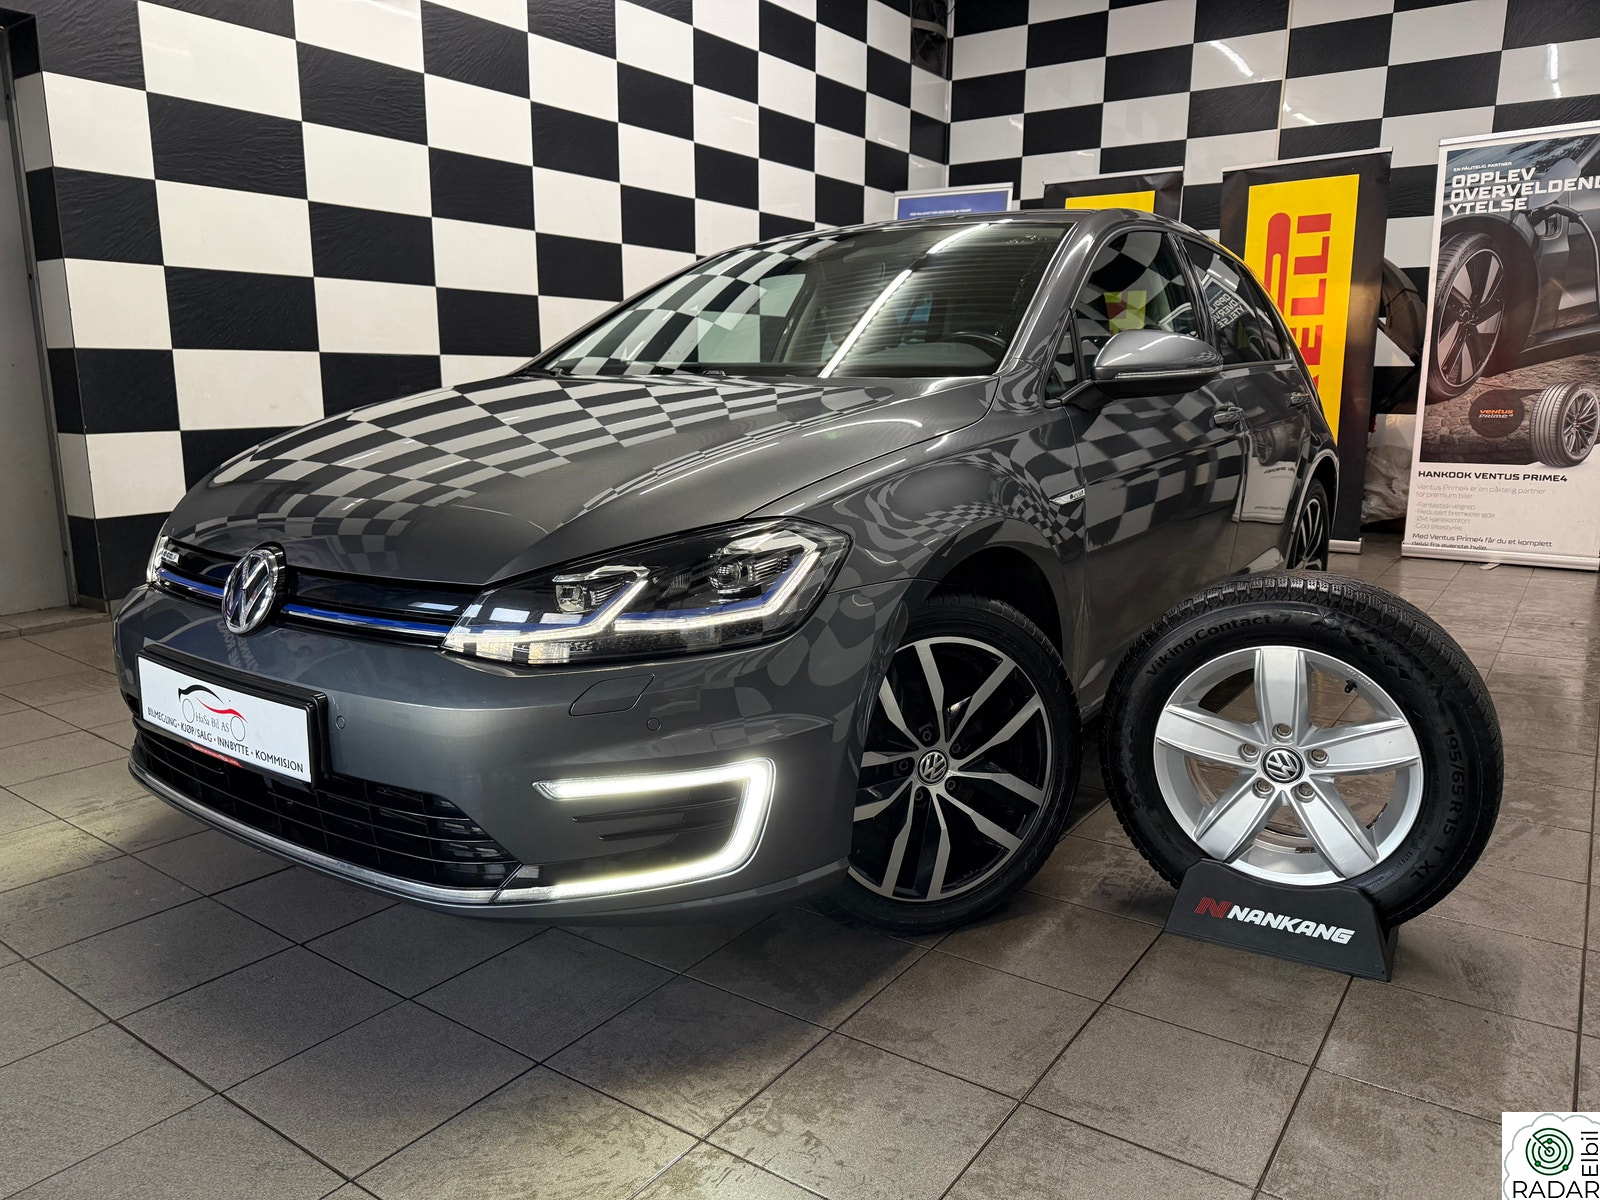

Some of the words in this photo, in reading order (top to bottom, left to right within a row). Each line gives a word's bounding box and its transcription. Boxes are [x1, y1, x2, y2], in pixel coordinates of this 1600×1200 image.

[1452, 167, 1536, 188] OPPLEV
[1450, 197, 1528, 216] YTELSE
[1474, 472, 1519, 480] VENTUS
[1523, 474, 1567, 482] PRIME4
[1146, 615, 1272, 676] VikingContact
[1279, 614, 1291, 624] 7
[211, 718, 220, 729] Bil
[221, 722, 229, 732] AS
[217, 737, 249, 756] INNBYTTE
[255, 750, 303, 773] KOMMISJON
[1444, 728, 1464, 796] 195/65
[1410, 860, 1435, 879] XL
[1227, 905, 1355, 944] NANKANG
